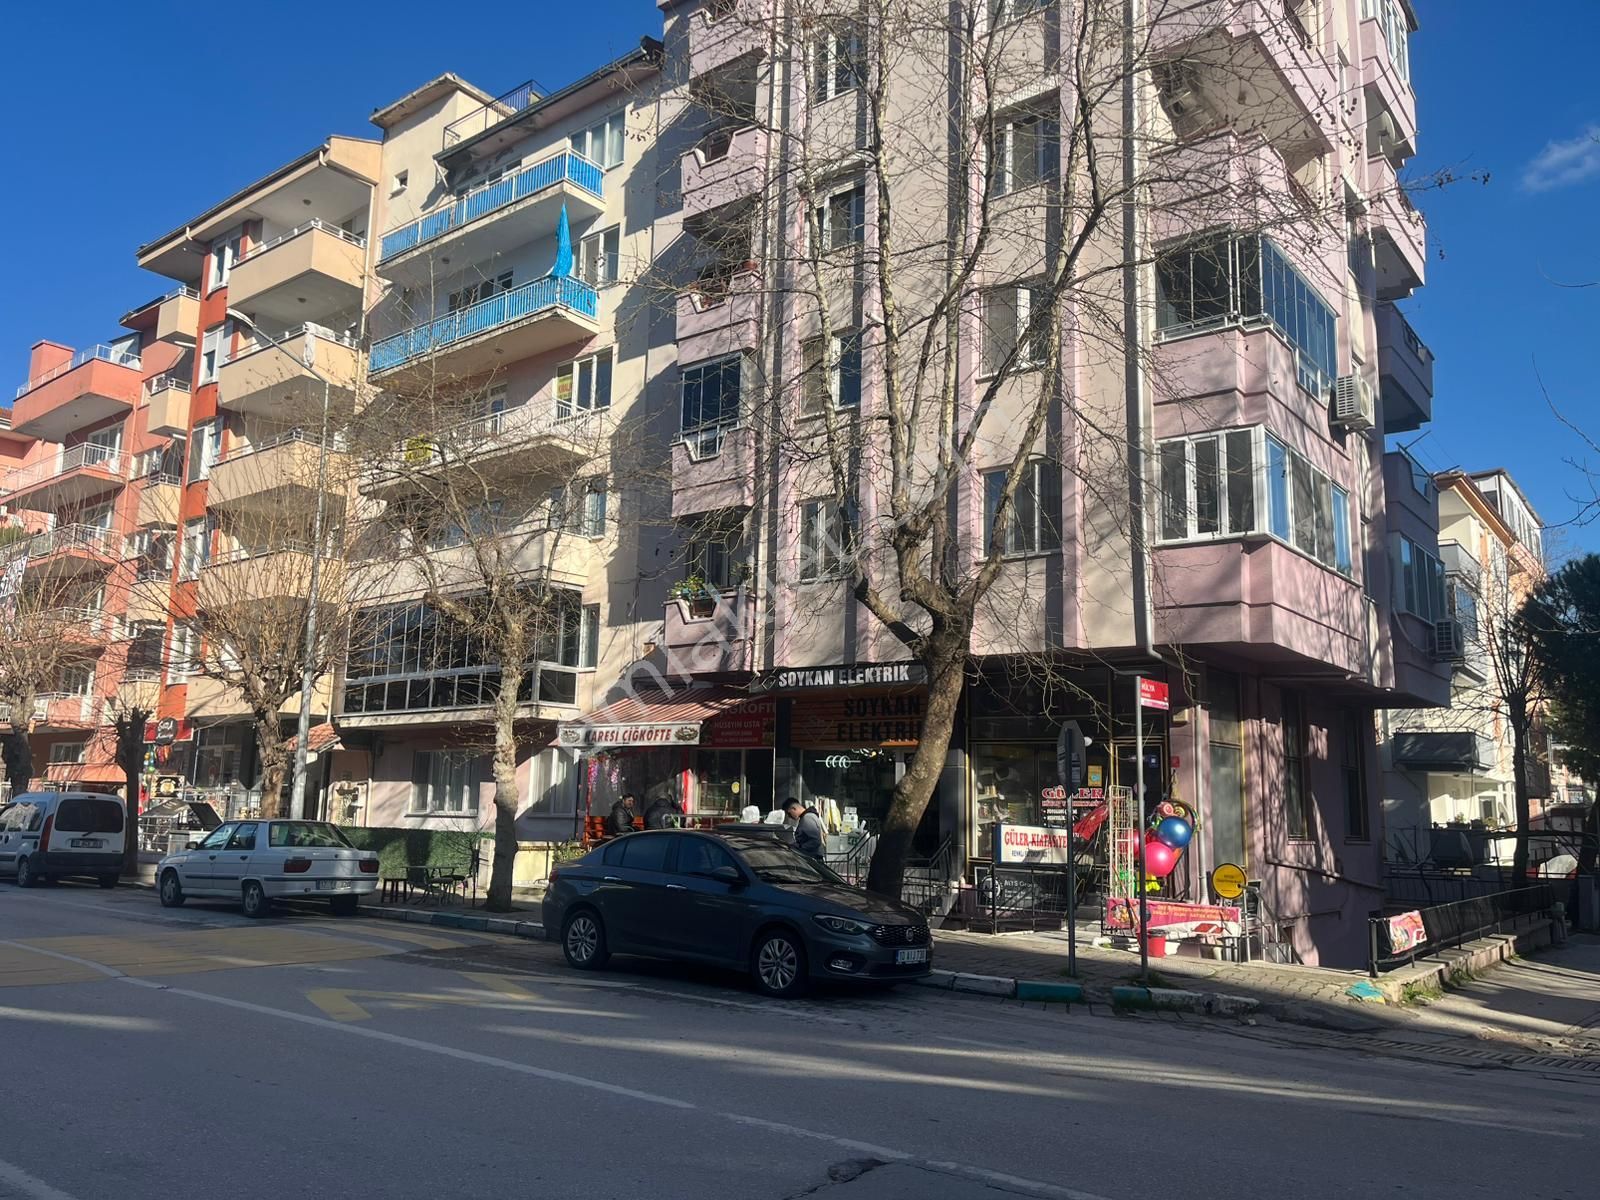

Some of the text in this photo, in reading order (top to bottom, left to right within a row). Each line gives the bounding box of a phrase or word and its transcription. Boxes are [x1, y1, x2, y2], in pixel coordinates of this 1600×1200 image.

[778, 669, 834, 687] SOYKAN
[844, 696, 921, 716] SOYKAN
[743, 719, 760, 729] USTA
[1004, 829, 1029, 847] GÜLER
